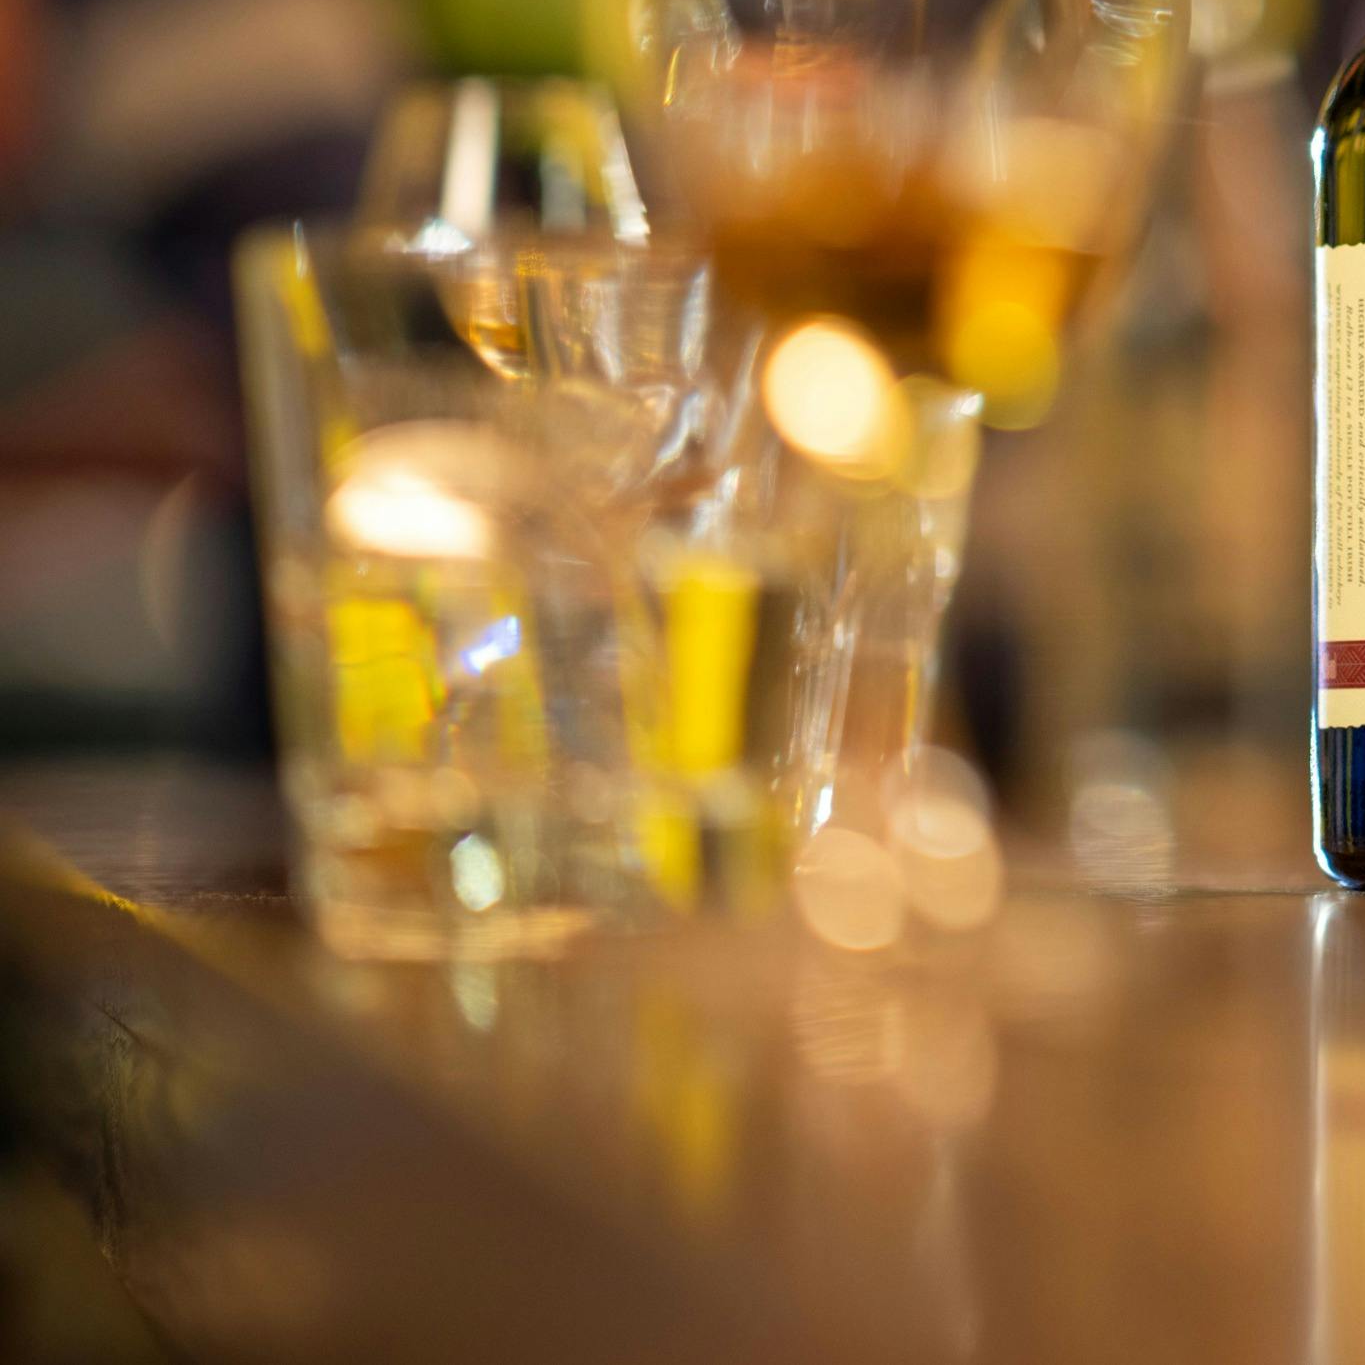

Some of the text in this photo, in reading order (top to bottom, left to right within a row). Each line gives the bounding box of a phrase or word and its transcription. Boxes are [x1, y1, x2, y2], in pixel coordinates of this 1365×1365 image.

[1345, 305, 1354, 370] Redbreast
[1357, 298, 1365, 349] HIGHLY
[1357, 353, 1365, 417] AWARDED
